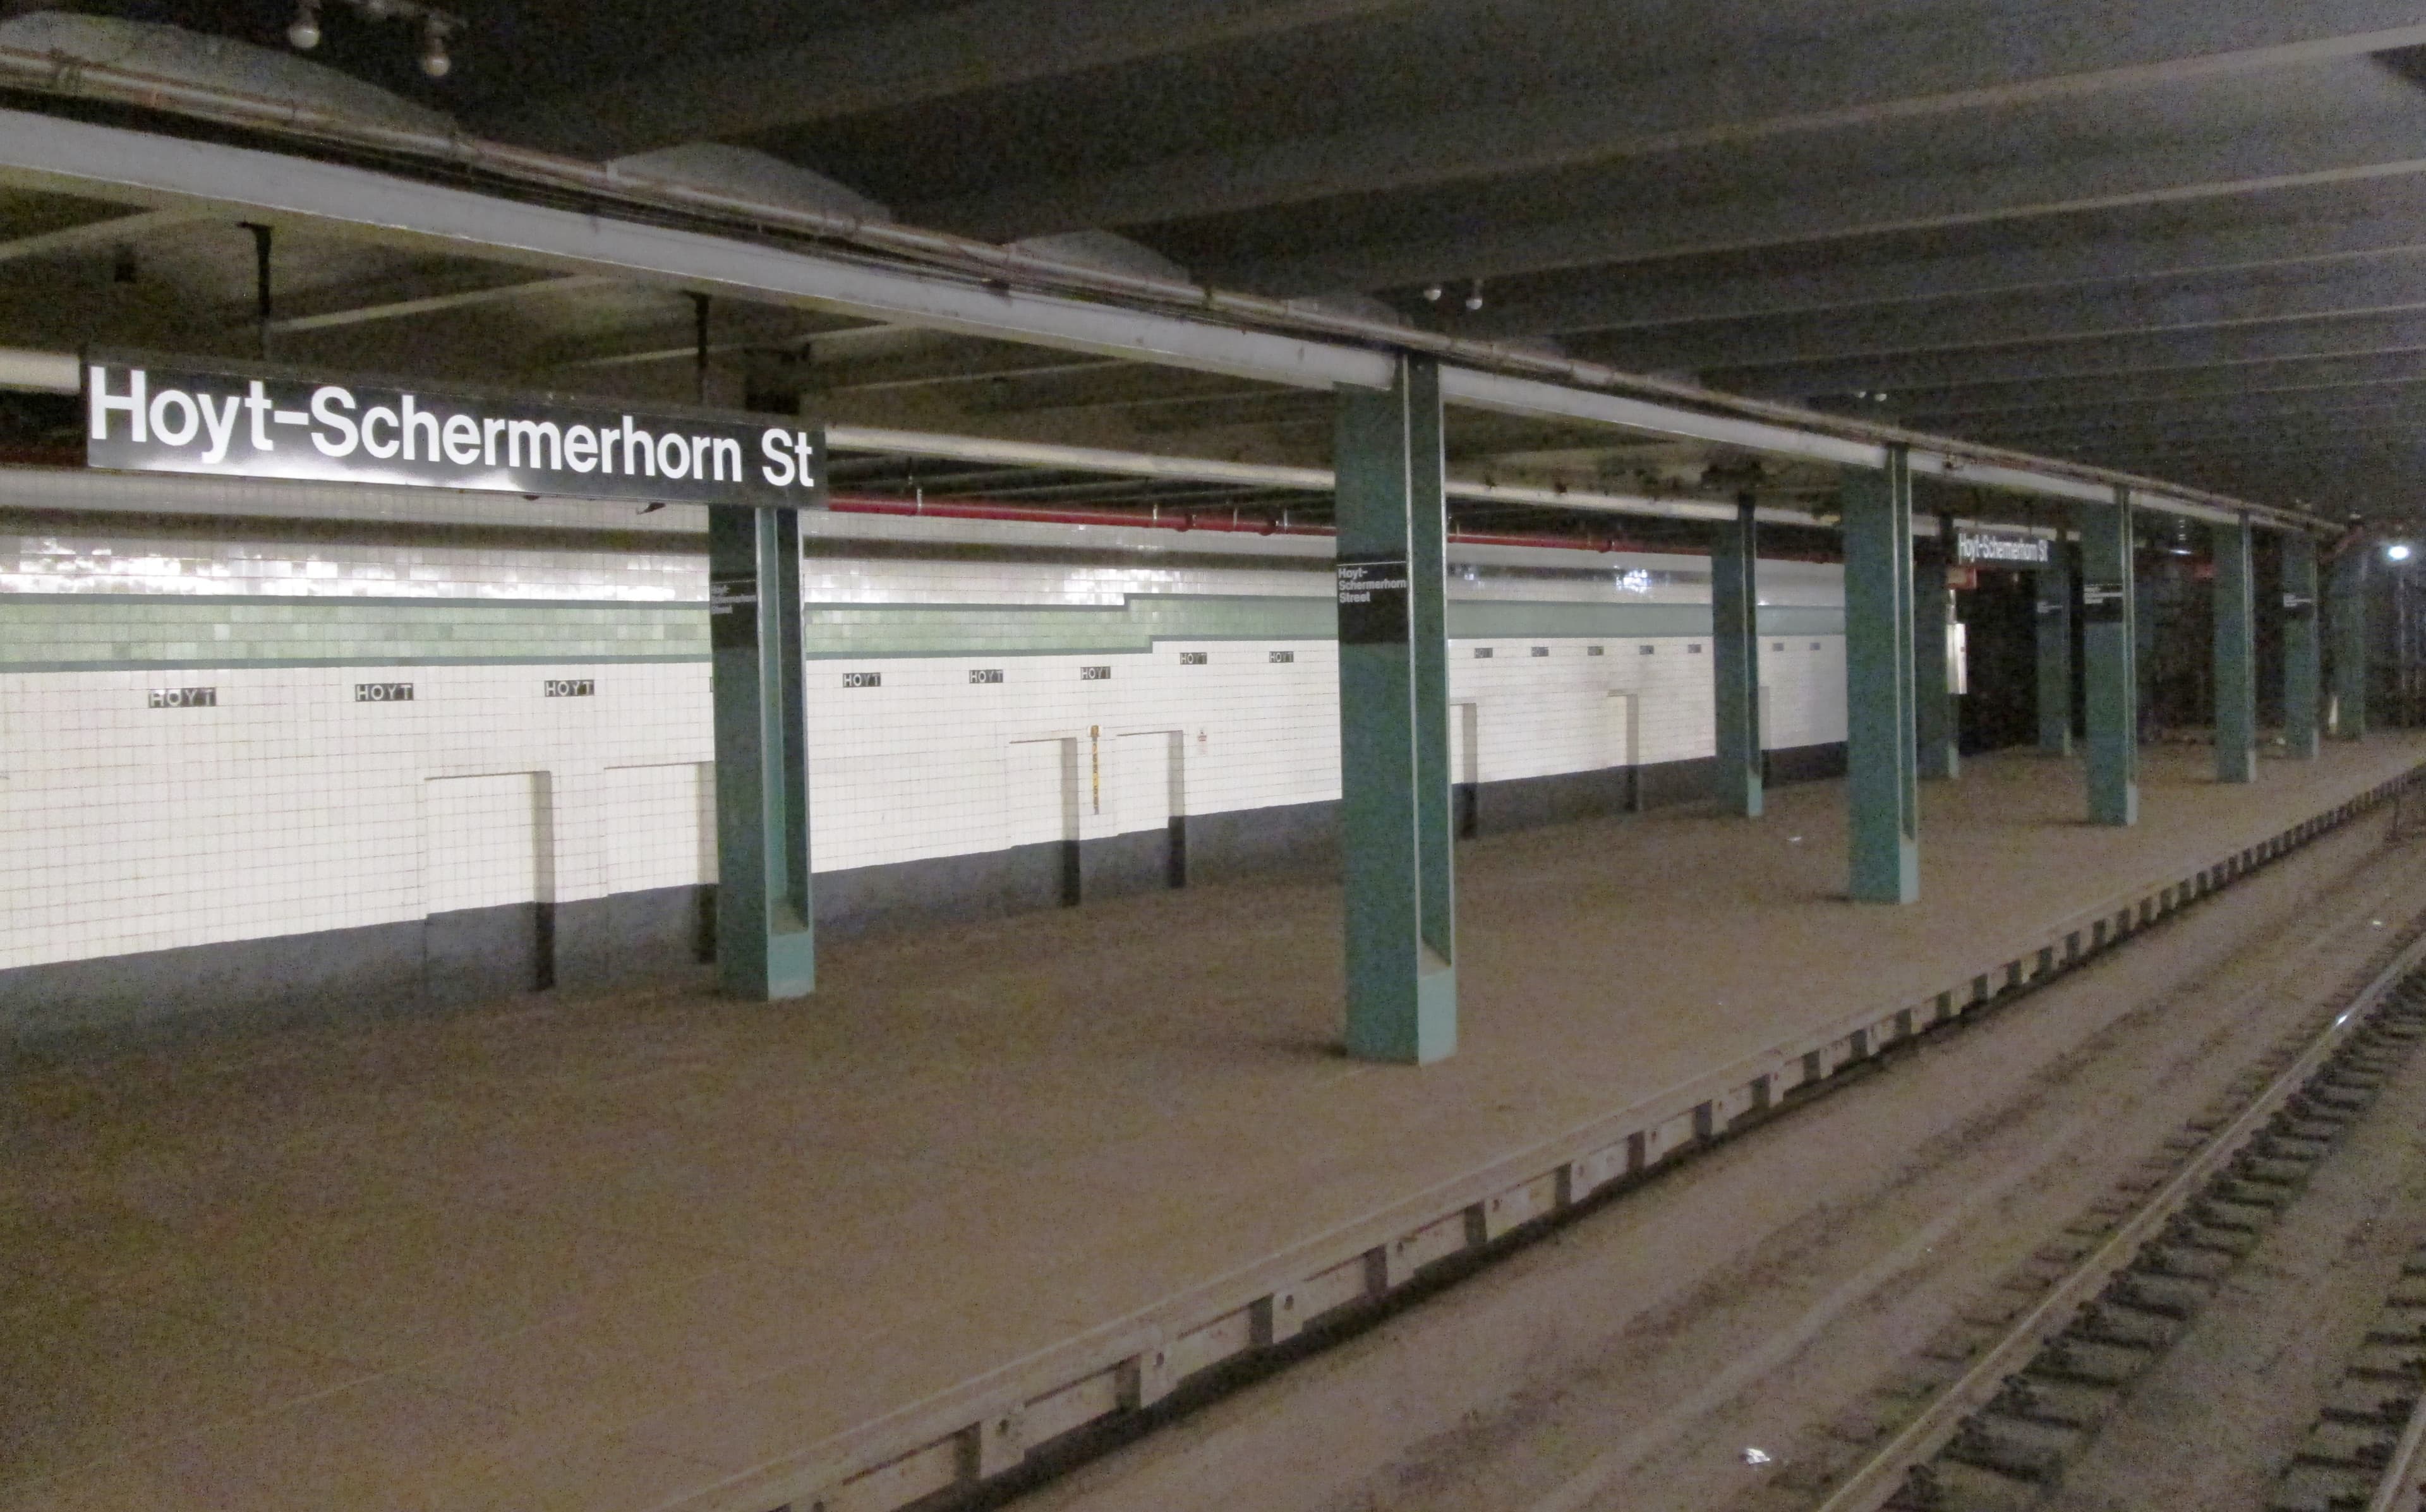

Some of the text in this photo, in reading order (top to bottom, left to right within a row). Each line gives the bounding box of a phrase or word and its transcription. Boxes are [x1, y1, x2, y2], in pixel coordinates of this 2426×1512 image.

[90, 365, 814, 488] Hoyt-Schermerhorn St
[1338, 567, 1368, 580] Hoyt-
[1339, 579, 1407, 591] Schermerhorn
[1339, 591, 1371, 603] Street
[843, 673, 880, 687] HOYT
[970, 670, 1003, 683] HOYT
[1081, 667, 1110, 680] HOYT
[356, 685, 412, 702] HOYT
[545, 681, 593, 697] HOYT
[150, 689, 213, 707] HOYT
